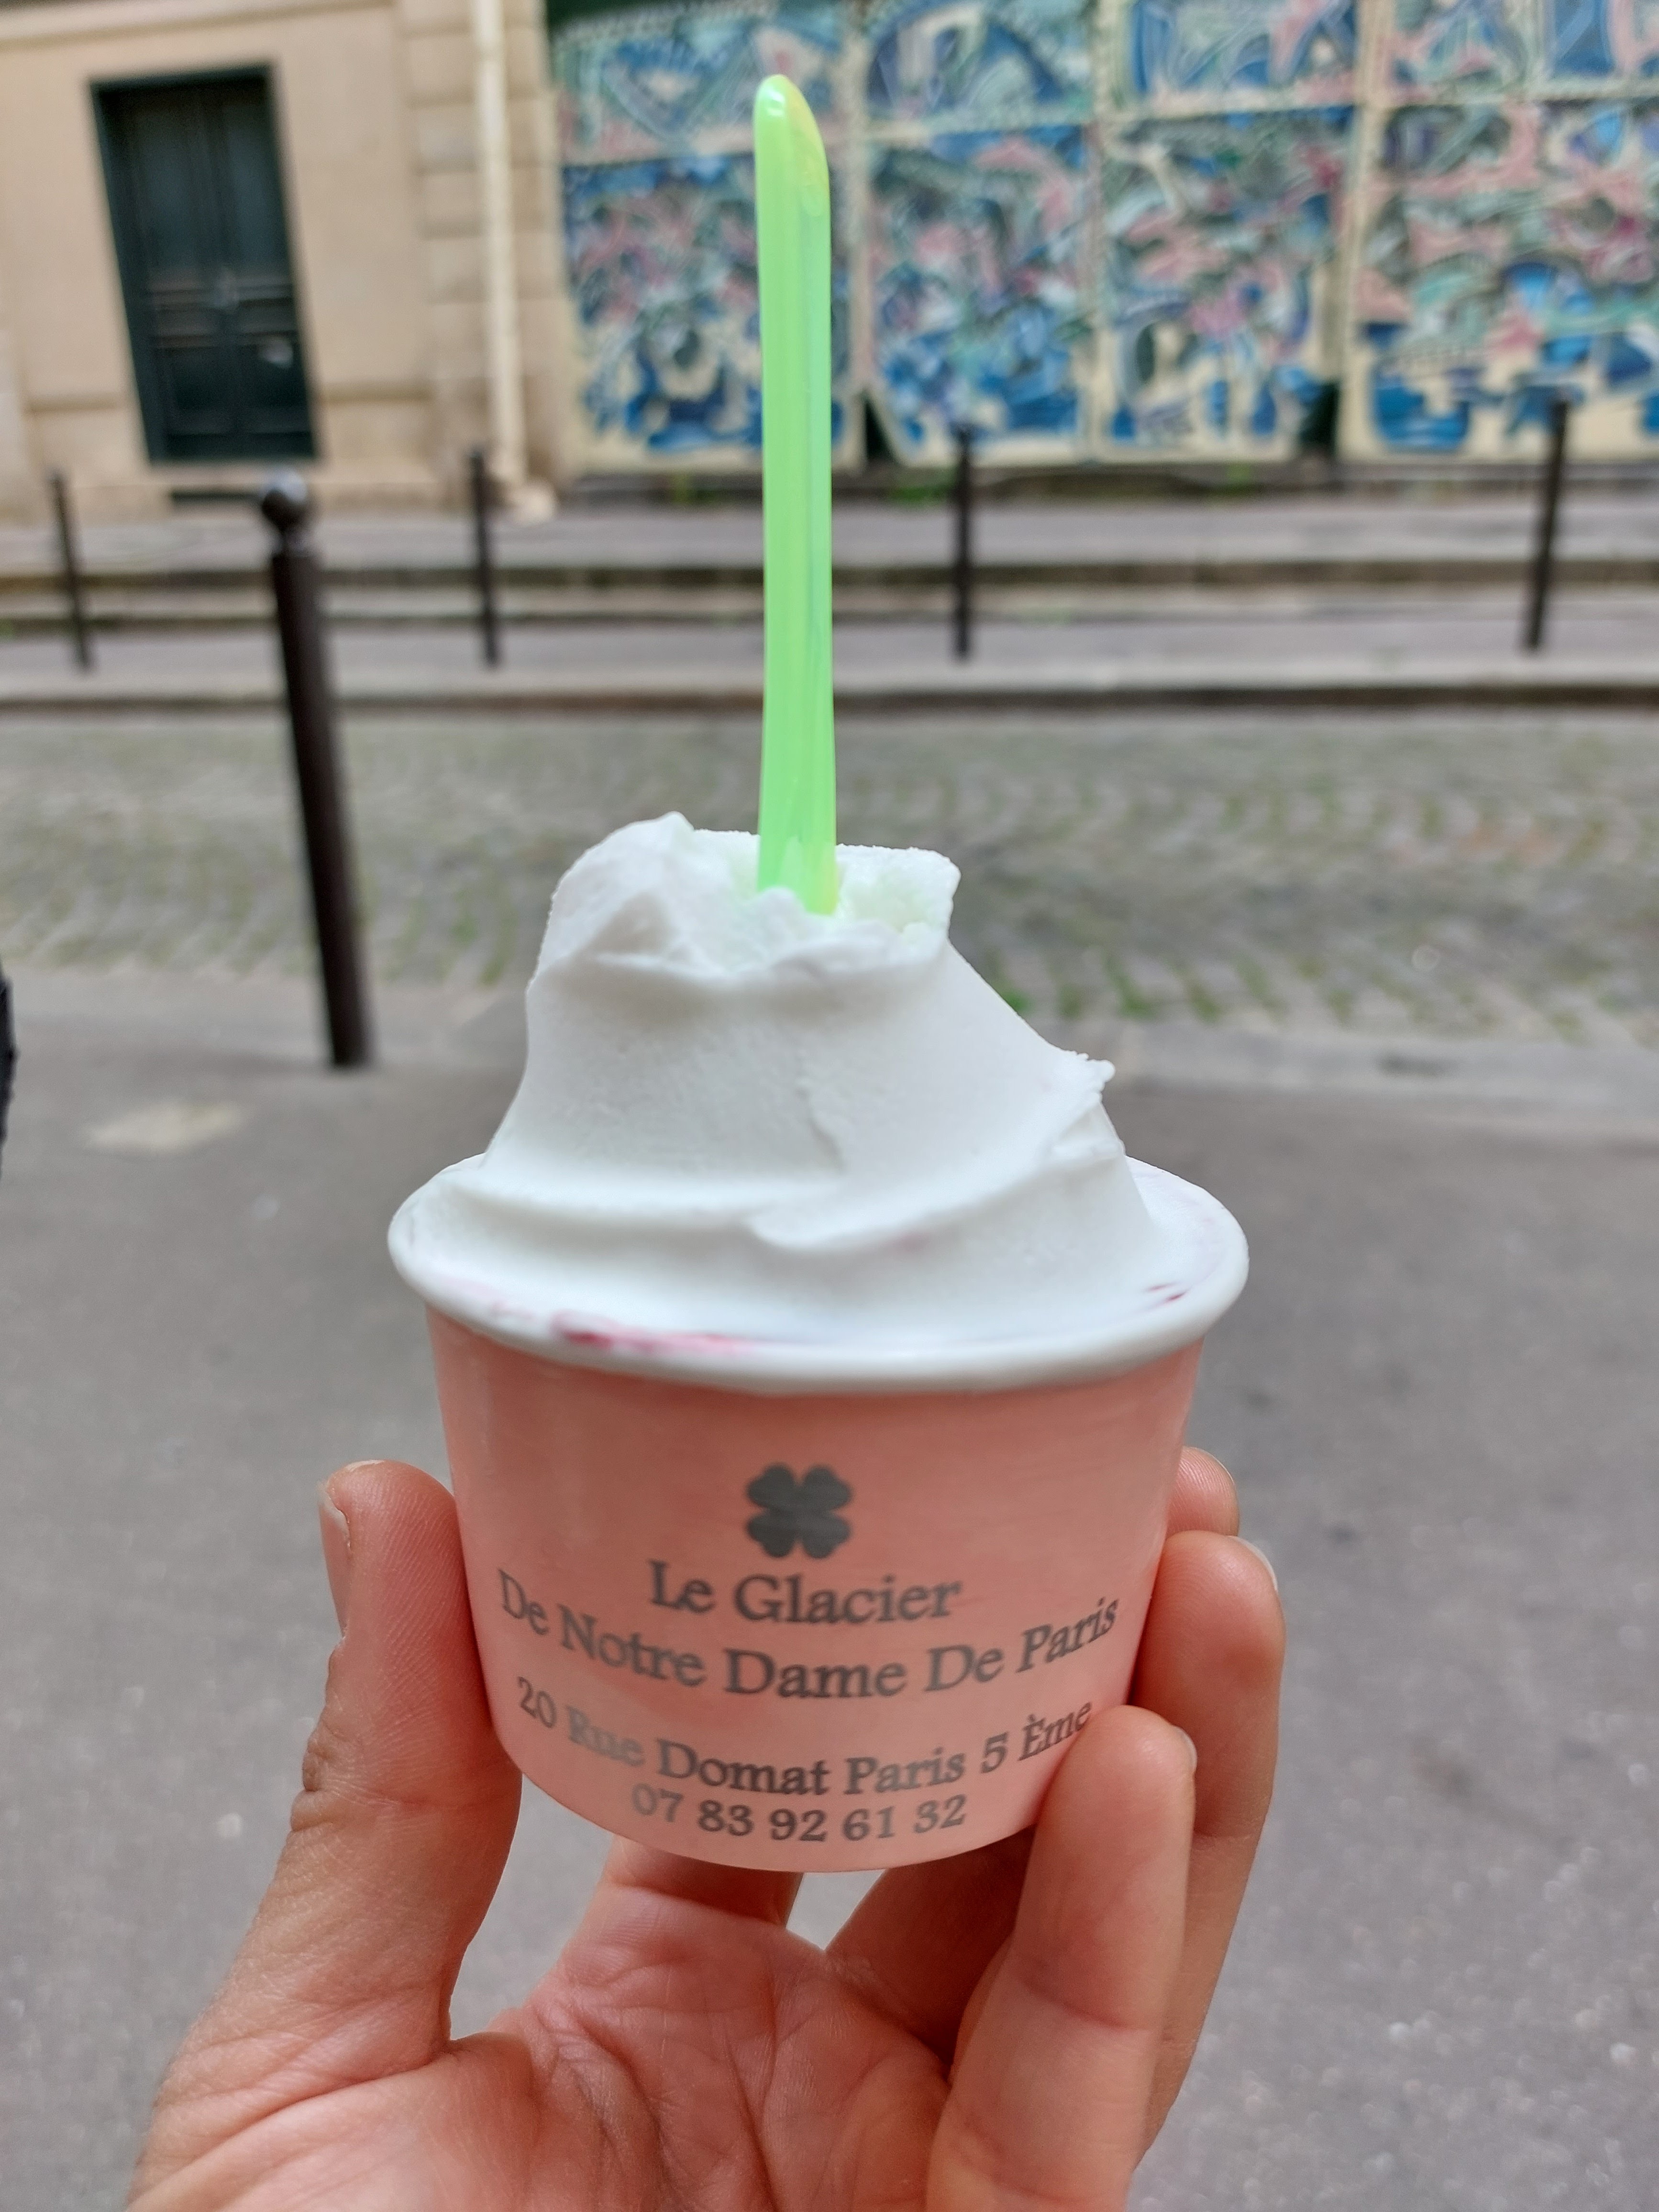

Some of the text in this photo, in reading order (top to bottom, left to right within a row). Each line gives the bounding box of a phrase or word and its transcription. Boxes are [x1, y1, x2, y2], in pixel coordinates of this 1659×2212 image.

[498, 1569, 1120, 1698] De Notre Dame De Paris
[649, 1560, 962, 1625] Le Glacier
[518, 1677, 1093, 1796] 20 Rue Domat Paris 5 Ème
[632, 1784, 966, 1842] 07 83 92 61 32
